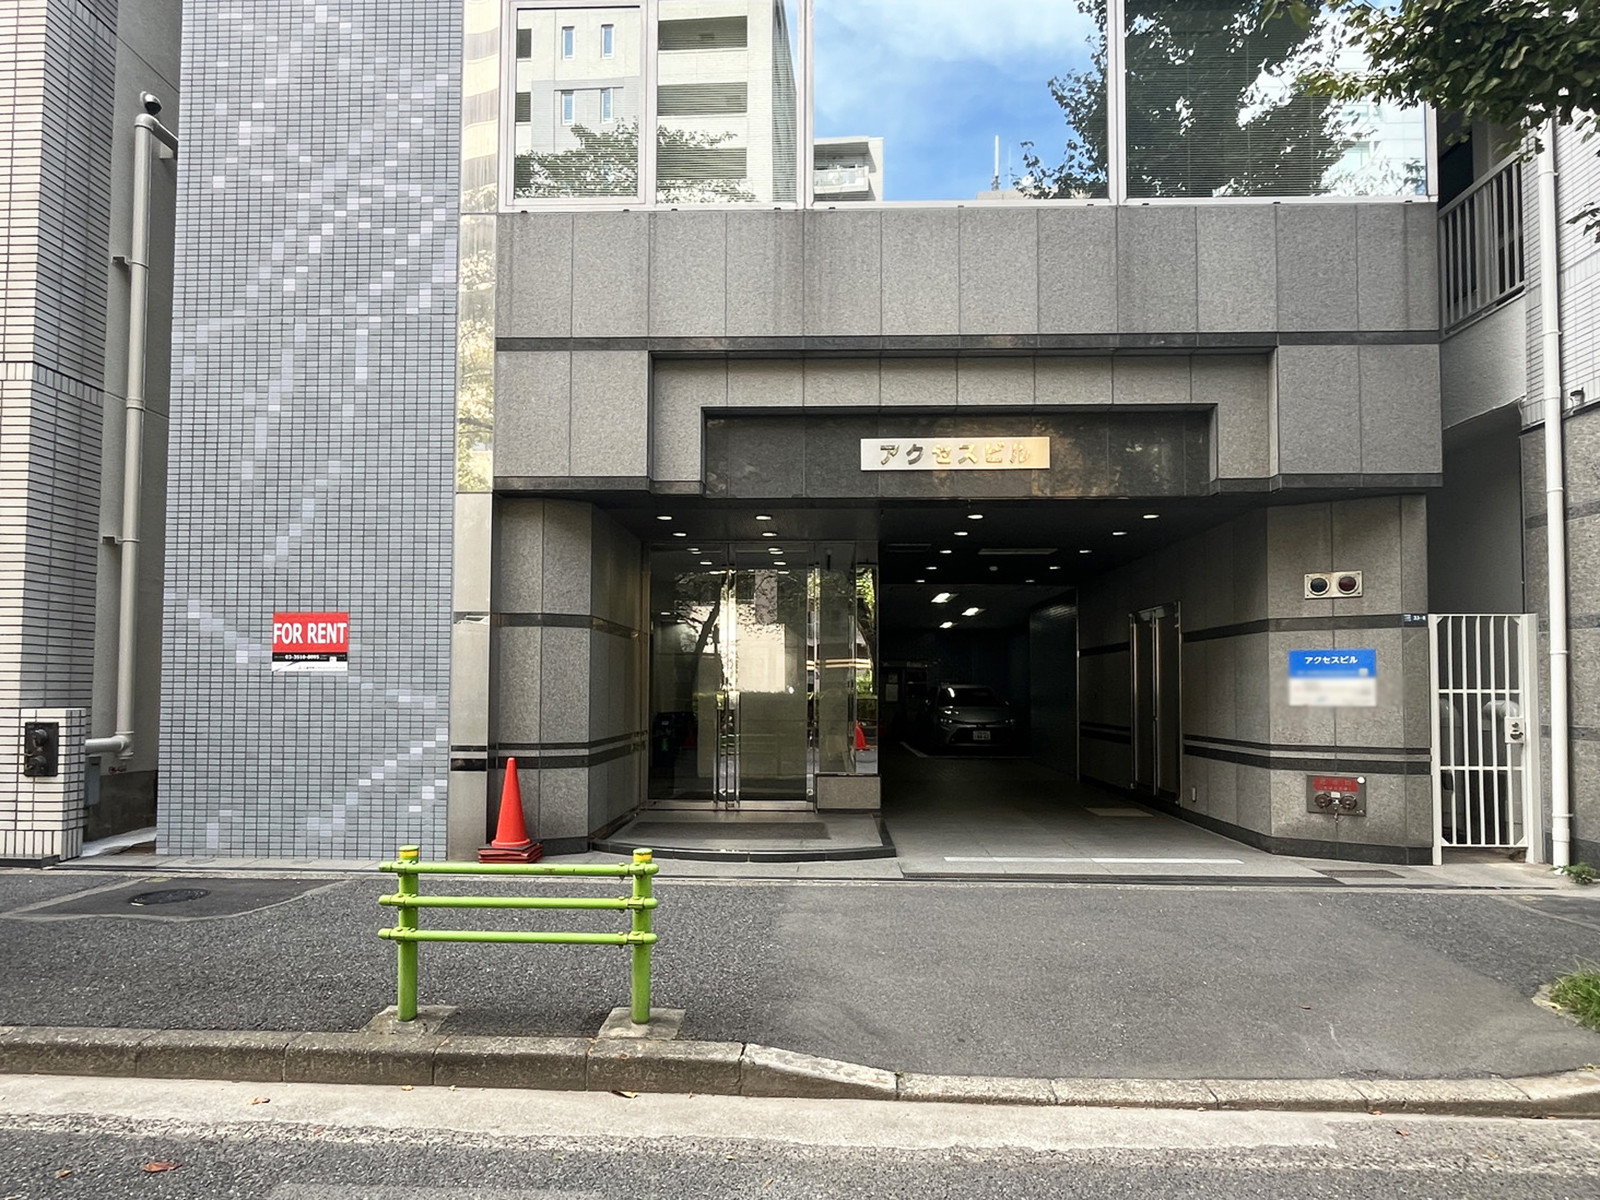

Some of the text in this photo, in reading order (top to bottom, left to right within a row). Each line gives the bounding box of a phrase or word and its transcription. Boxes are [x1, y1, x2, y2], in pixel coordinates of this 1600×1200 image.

[880, 441, 1031, 465] アクセスビル
[273, 622, 347, 644] FOR RENT
[1304, 656, 1358, 665] アクセスビル
